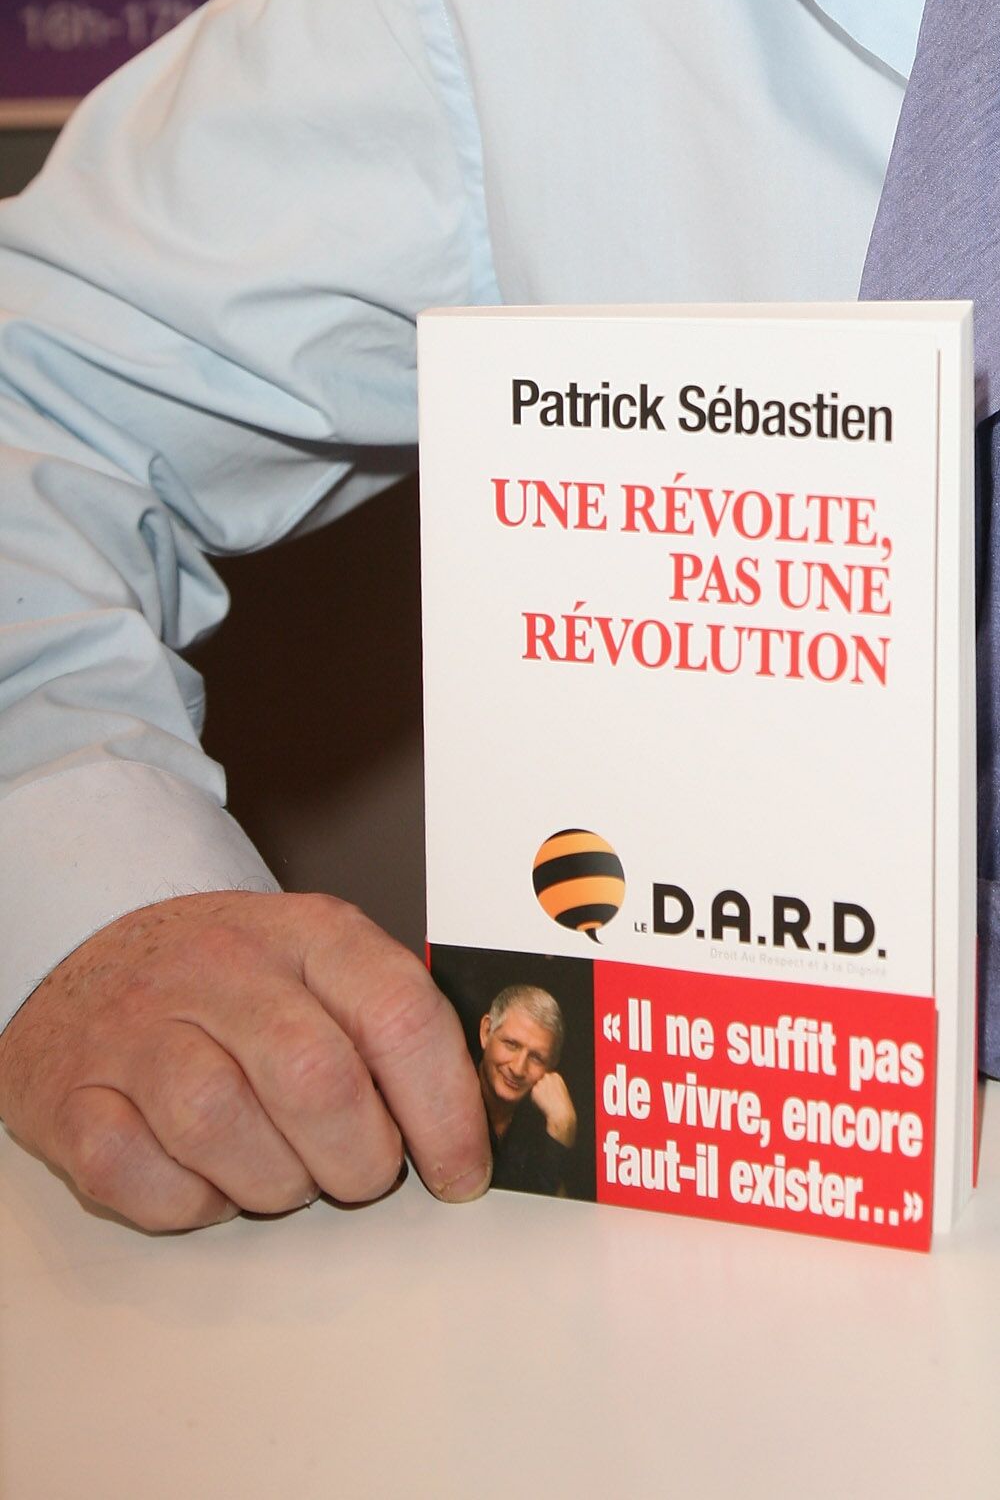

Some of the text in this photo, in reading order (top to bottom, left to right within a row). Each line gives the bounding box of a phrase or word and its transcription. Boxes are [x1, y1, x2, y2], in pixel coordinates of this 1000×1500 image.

[512, 379, 892, 441] Patrick Sébastien
[491, 472, 893, 560] UNE RÉVOLTE,
[669, 553, 892, 615] PAS UNE
[522, 601, 891, 686] RÉVOLUTION
[634, 883, 887, 958] LE D.A.R.D.
[710, 947, 738, 962] Droit
[741, 953, 756, 965] Au
[760, 953, 804, 970] Respect
[807, 960, 819, 970] et
[847, 963, 887, 978] Dignité
[665, 1014, 714, 1060] ne
[727, 1015, 837, 1076] suffit
[849, 1035, 925, 1091] pas
[602, 1064, 924, 1158] de vivre, encore
[602, 1130, 719, 1199] faut-il
